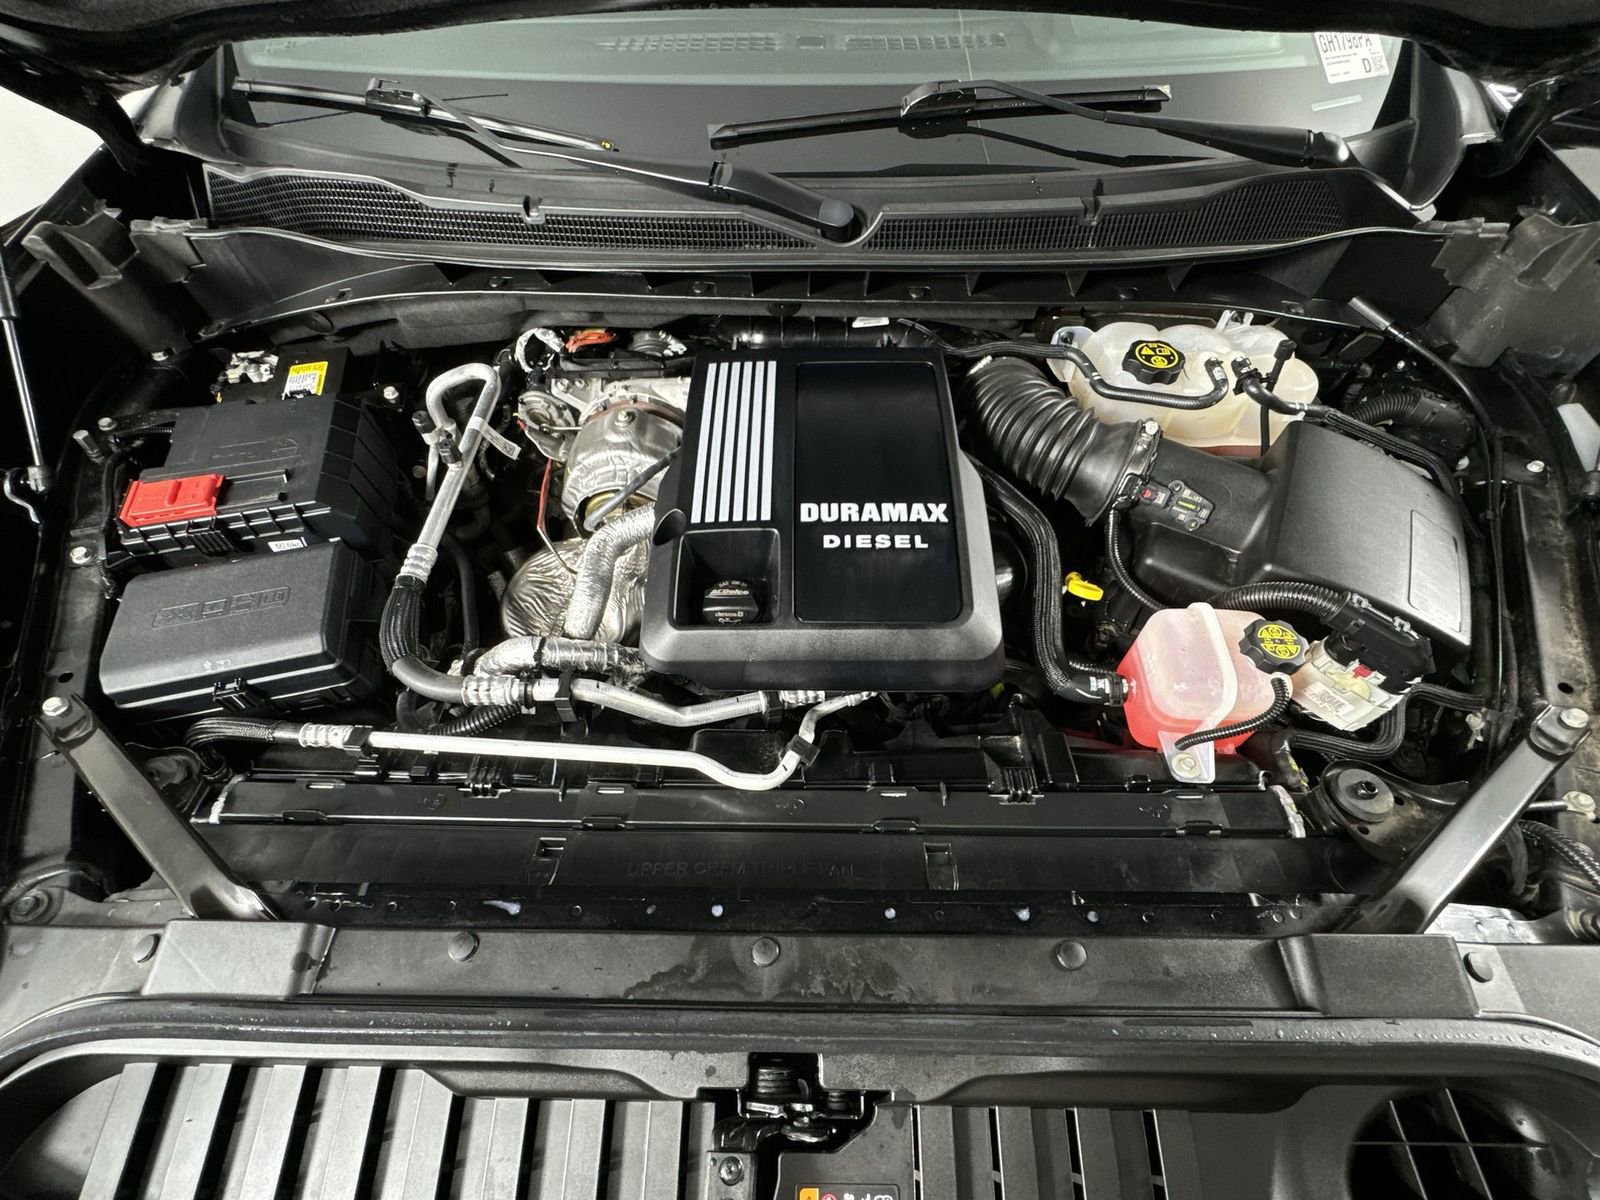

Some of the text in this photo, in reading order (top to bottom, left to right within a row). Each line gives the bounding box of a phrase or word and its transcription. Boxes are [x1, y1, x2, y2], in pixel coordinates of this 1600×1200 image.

[1361, 57, 1372, 73] D
[800, 502, 949, 523] DURAMAX
[822, 534, 929, 549] DIESEL
[626, 861, 690, 878] UPPER
